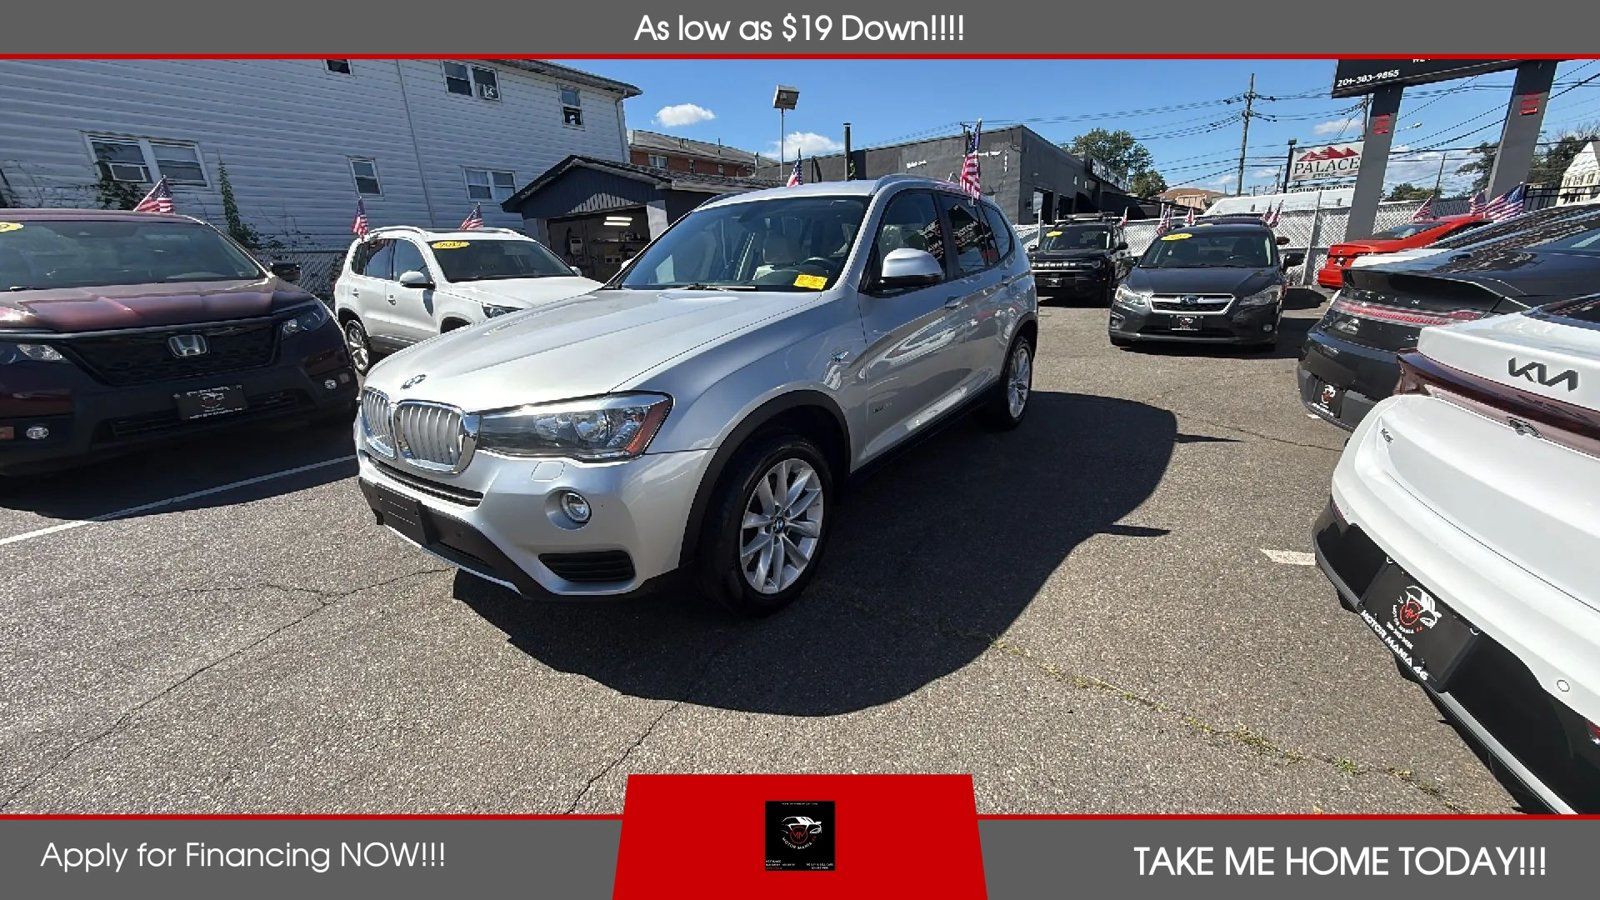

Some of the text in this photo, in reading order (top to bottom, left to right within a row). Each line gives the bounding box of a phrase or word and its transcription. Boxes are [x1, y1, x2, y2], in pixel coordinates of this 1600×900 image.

[1294, 156, 1360, 175] PALACE
[1360, 609, 1387, 638] MOTOR
[1385, 636, 1412, 667] MANIA
